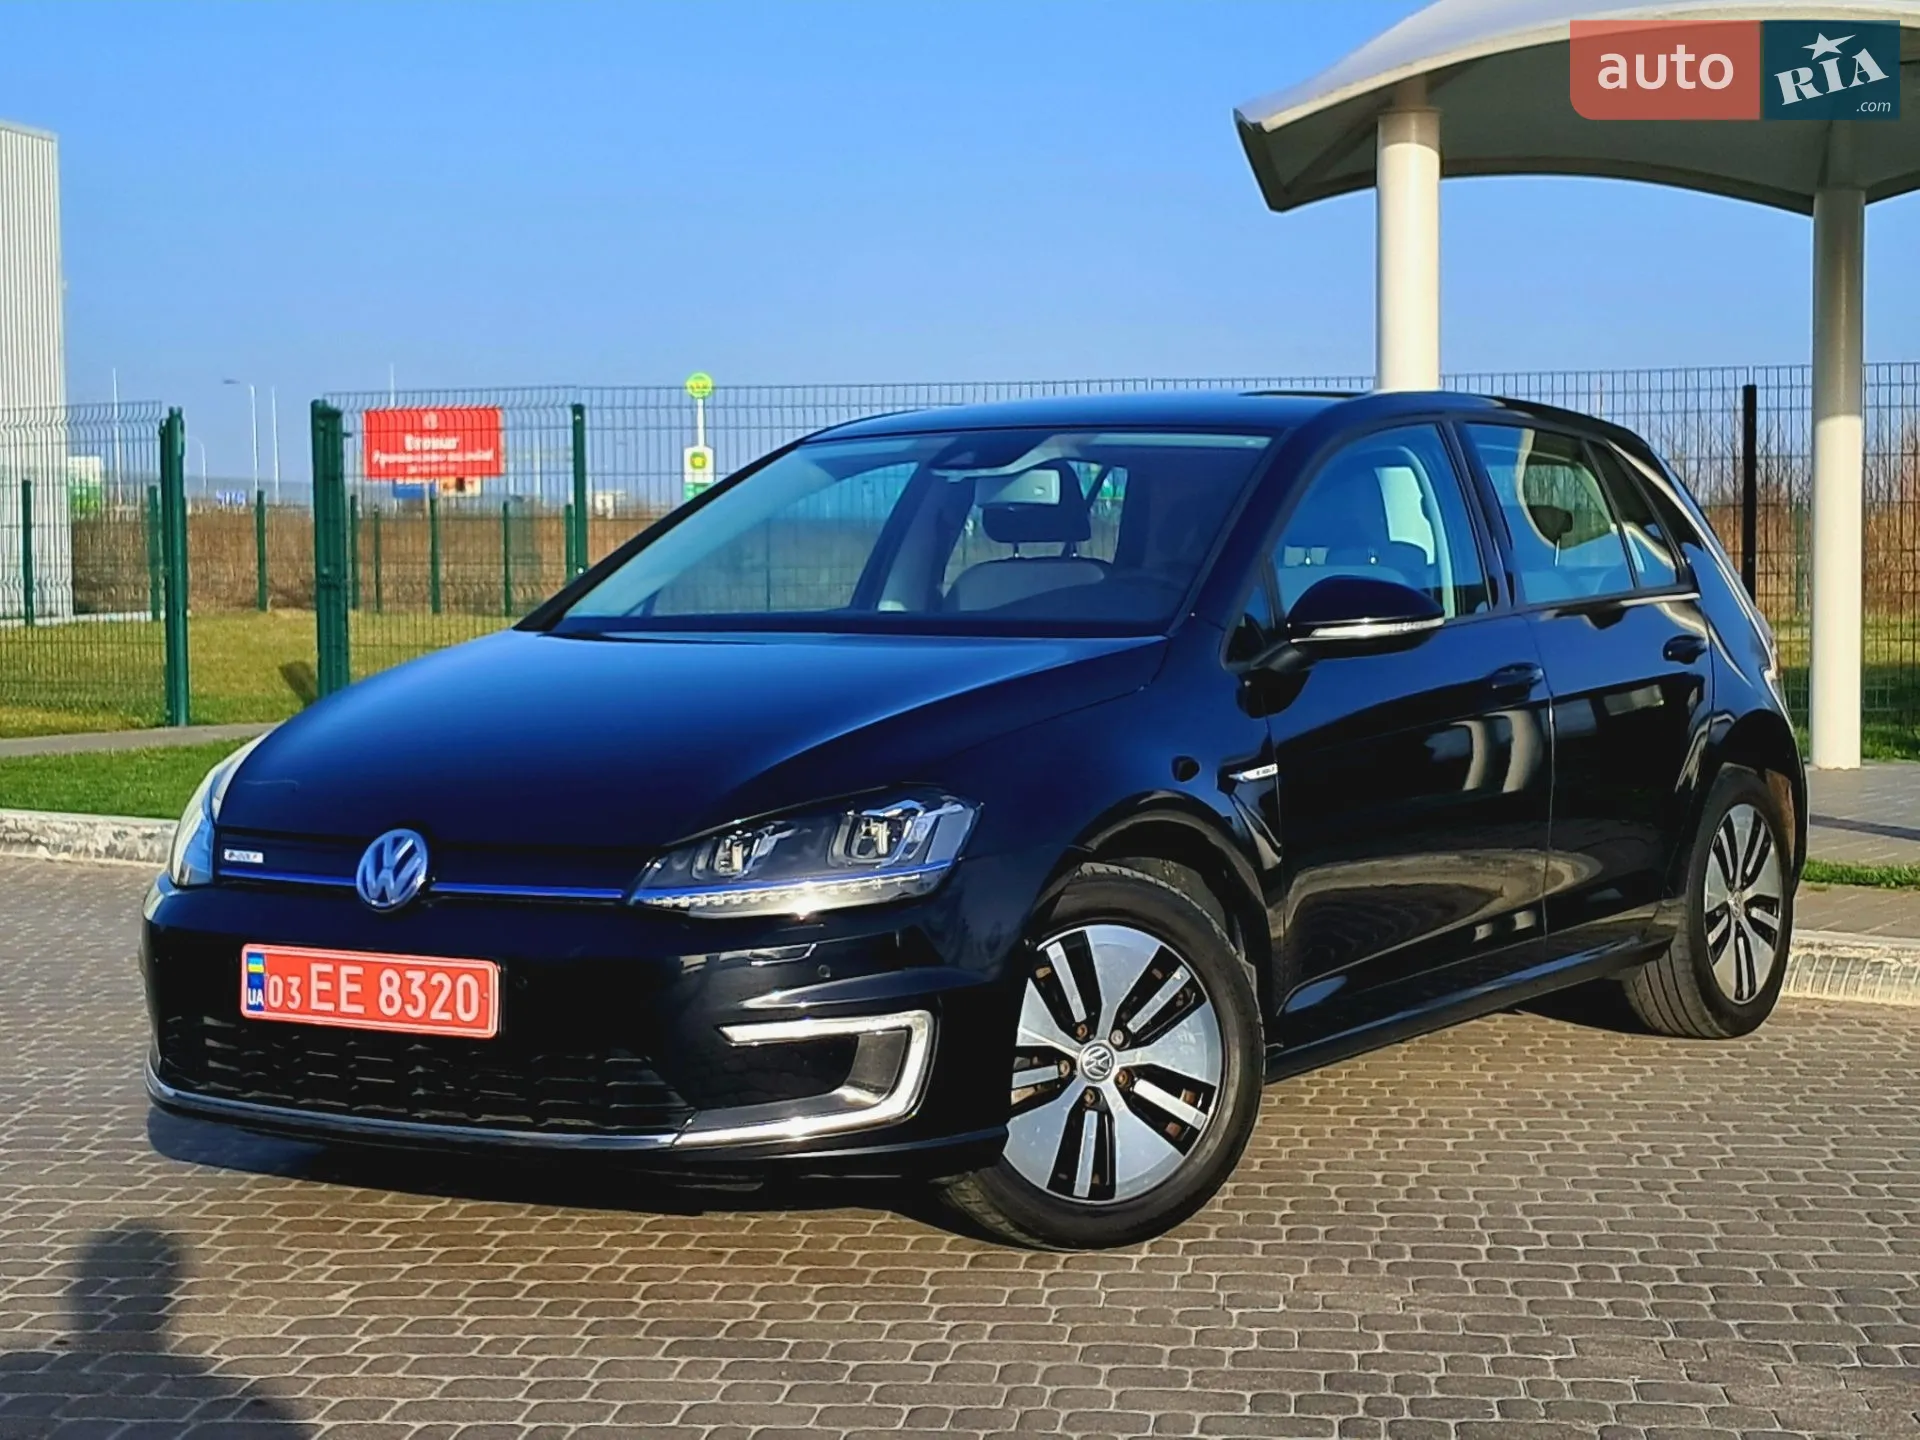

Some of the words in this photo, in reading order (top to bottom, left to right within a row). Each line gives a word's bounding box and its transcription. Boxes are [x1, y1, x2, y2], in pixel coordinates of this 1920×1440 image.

[247, 988, 265, 1007] UA
[267, 974, 302, 1010] 03
[310, 962, 365, 1014] EE
[378, 968, 480, 1022] 8320
